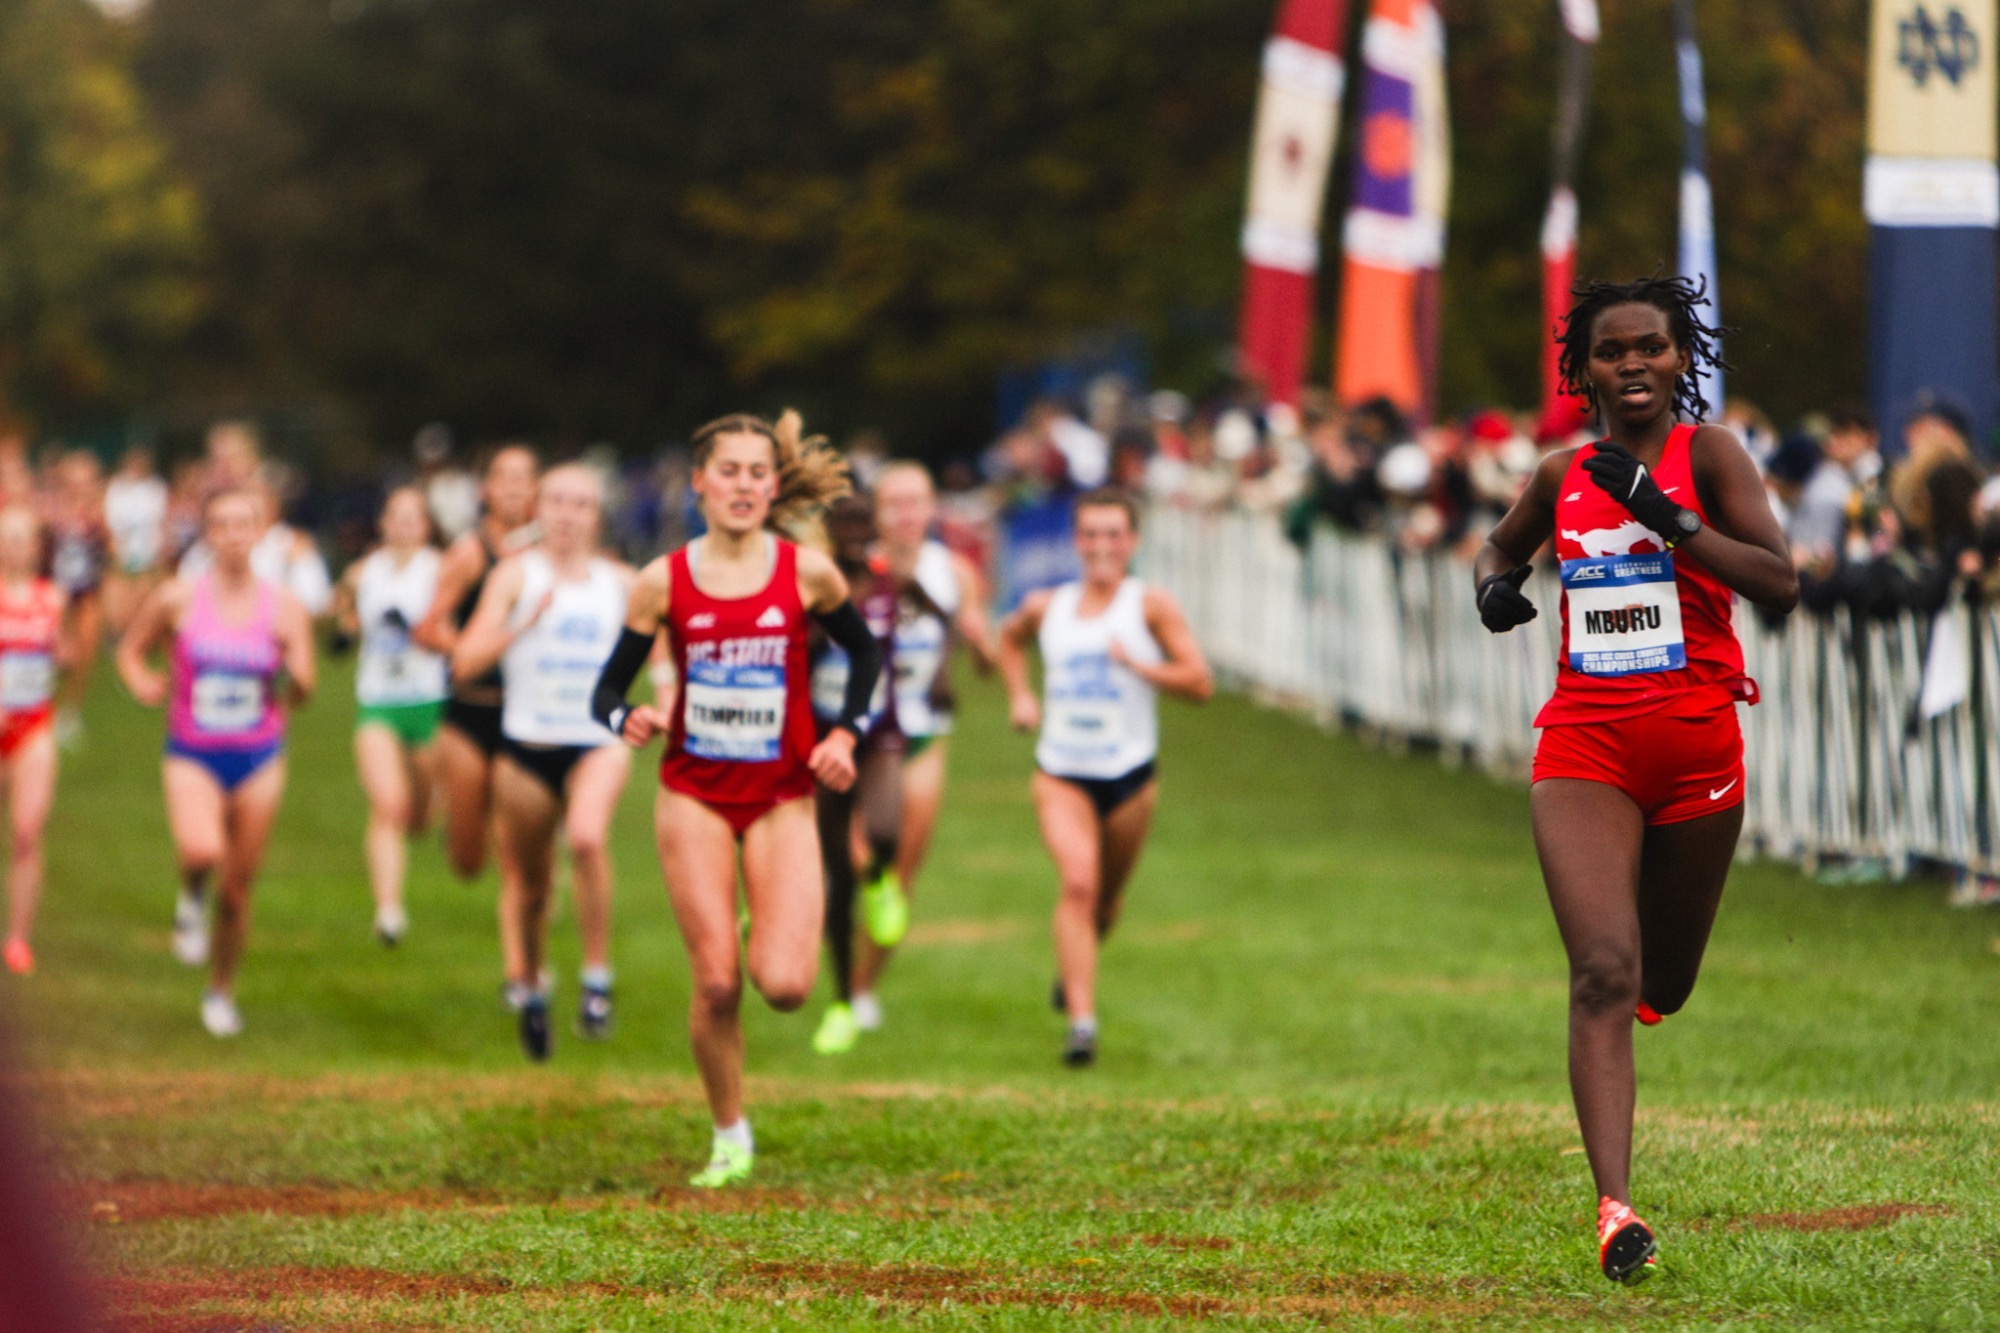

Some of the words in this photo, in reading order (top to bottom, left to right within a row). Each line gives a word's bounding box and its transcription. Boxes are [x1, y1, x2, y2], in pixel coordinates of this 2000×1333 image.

[1571, 565, 1606, 581] ACC
[1614, 566, 1663, 578] GREATNESS
[1585, 605, 1661, 635] MBURU
[1582, 655, 1670, 672] CHAMPIONSHIPS
